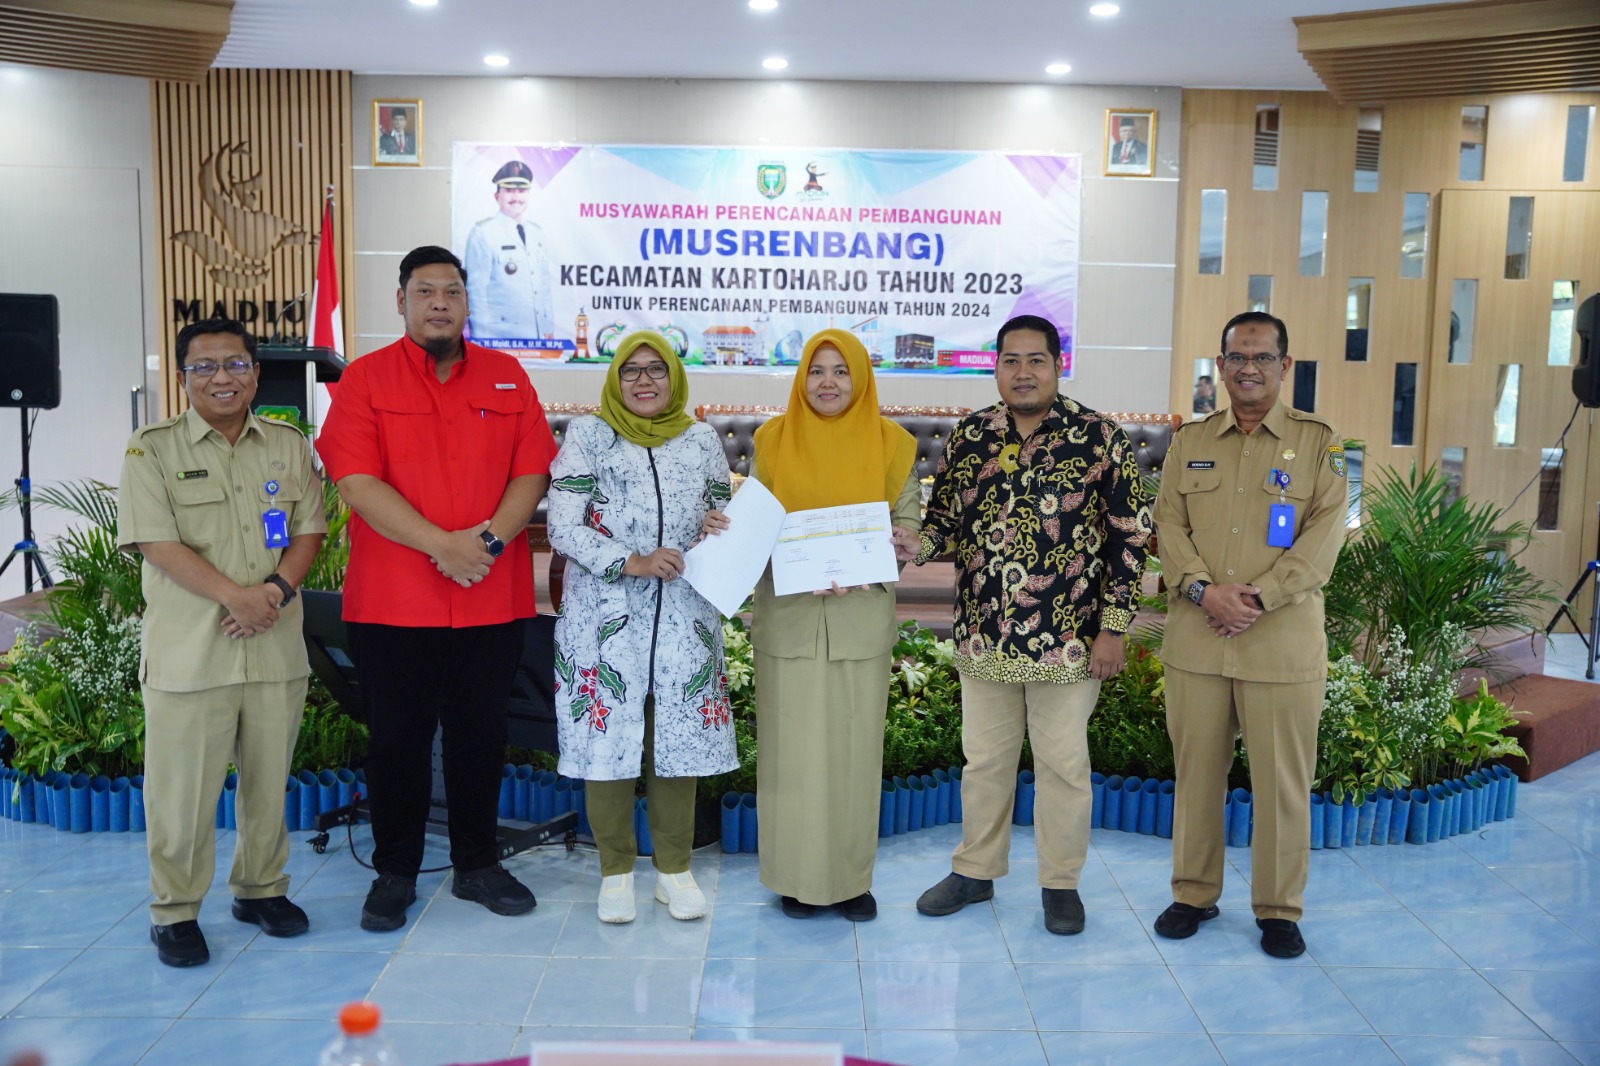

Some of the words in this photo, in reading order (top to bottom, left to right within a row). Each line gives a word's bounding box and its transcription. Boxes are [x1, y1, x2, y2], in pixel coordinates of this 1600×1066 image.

[580, 203, 708, 219] MUSYAWARAH
[715, 205, 852, 222] PERENCANAAN
[859, 208, 1001, 225] PEMBANGUNAN
[640, 228, 944, 266] (MUSRENBANG)
[560, 265, 702, 289] KECAMATAN
[711, 267, 868, 292] KARTOHARJO
[876, 270, 954, 293] TAHUN
[964, 272, 1023, 295] 2023
[173, 299, 305, 323] MADIU
[592, 296, 643, 311] UNTUK
[649, 297, 763, 314] PERENCANAAN
[768, 299, 888, 316] PEMBANGUNAN
[894, 302, 945, 316] TAHUN
[952, 303, 990, 317] 2024
[960, 354, 993, 365] MADIUN,
